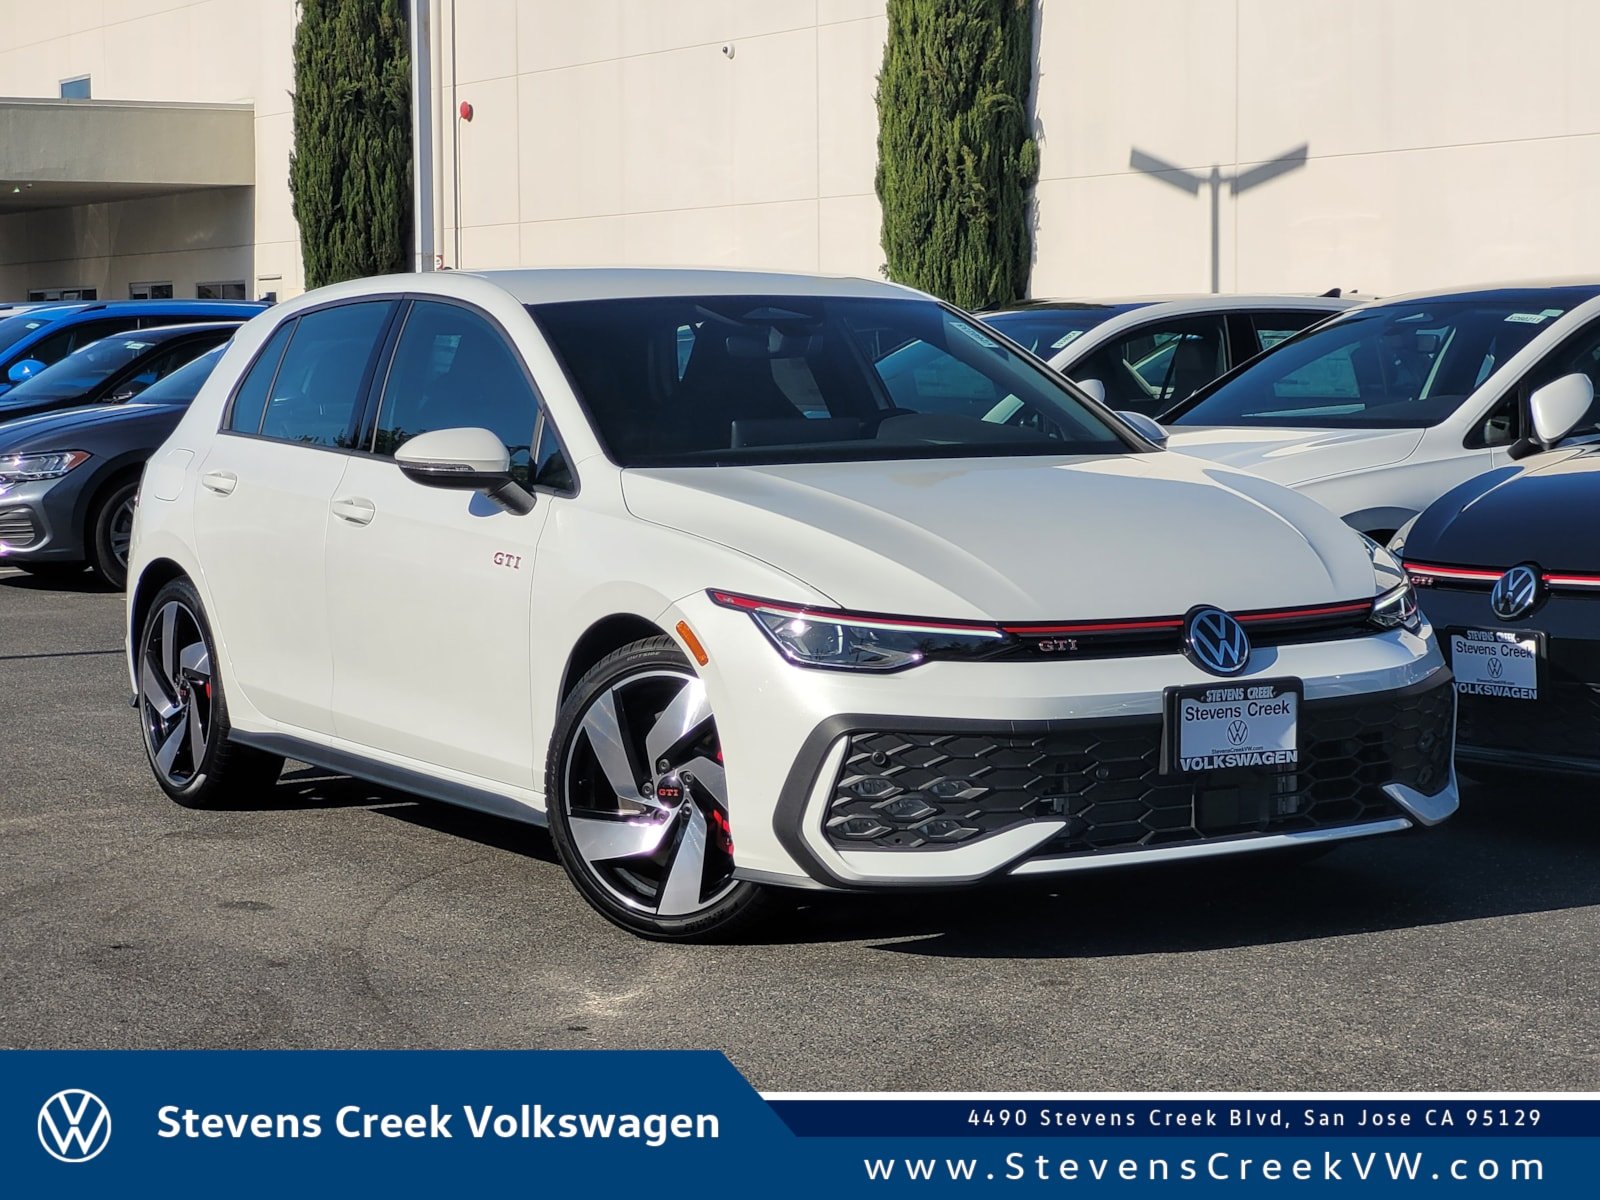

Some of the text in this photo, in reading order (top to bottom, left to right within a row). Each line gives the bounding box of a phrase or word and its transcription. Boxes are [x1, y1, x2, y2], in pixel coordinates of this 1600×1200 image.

[493, 551, 521, 569] GTI
[1467, 630, 1494, 641] STEVENS
[1039, 639, 1078, 651] GTI
[1456, 641, 1533, 659] Stevens Creek
[1206, 686, 1274, 702] STEVENS CREEK
[1185, 700, 1290, 721] Stevens Creek
[1211, 745, 1264, 755] StevensCreekVW.com
[1180, 750, 1298, 772] VOLKSWAGEN
[658, 788, 679, 797] GTI
